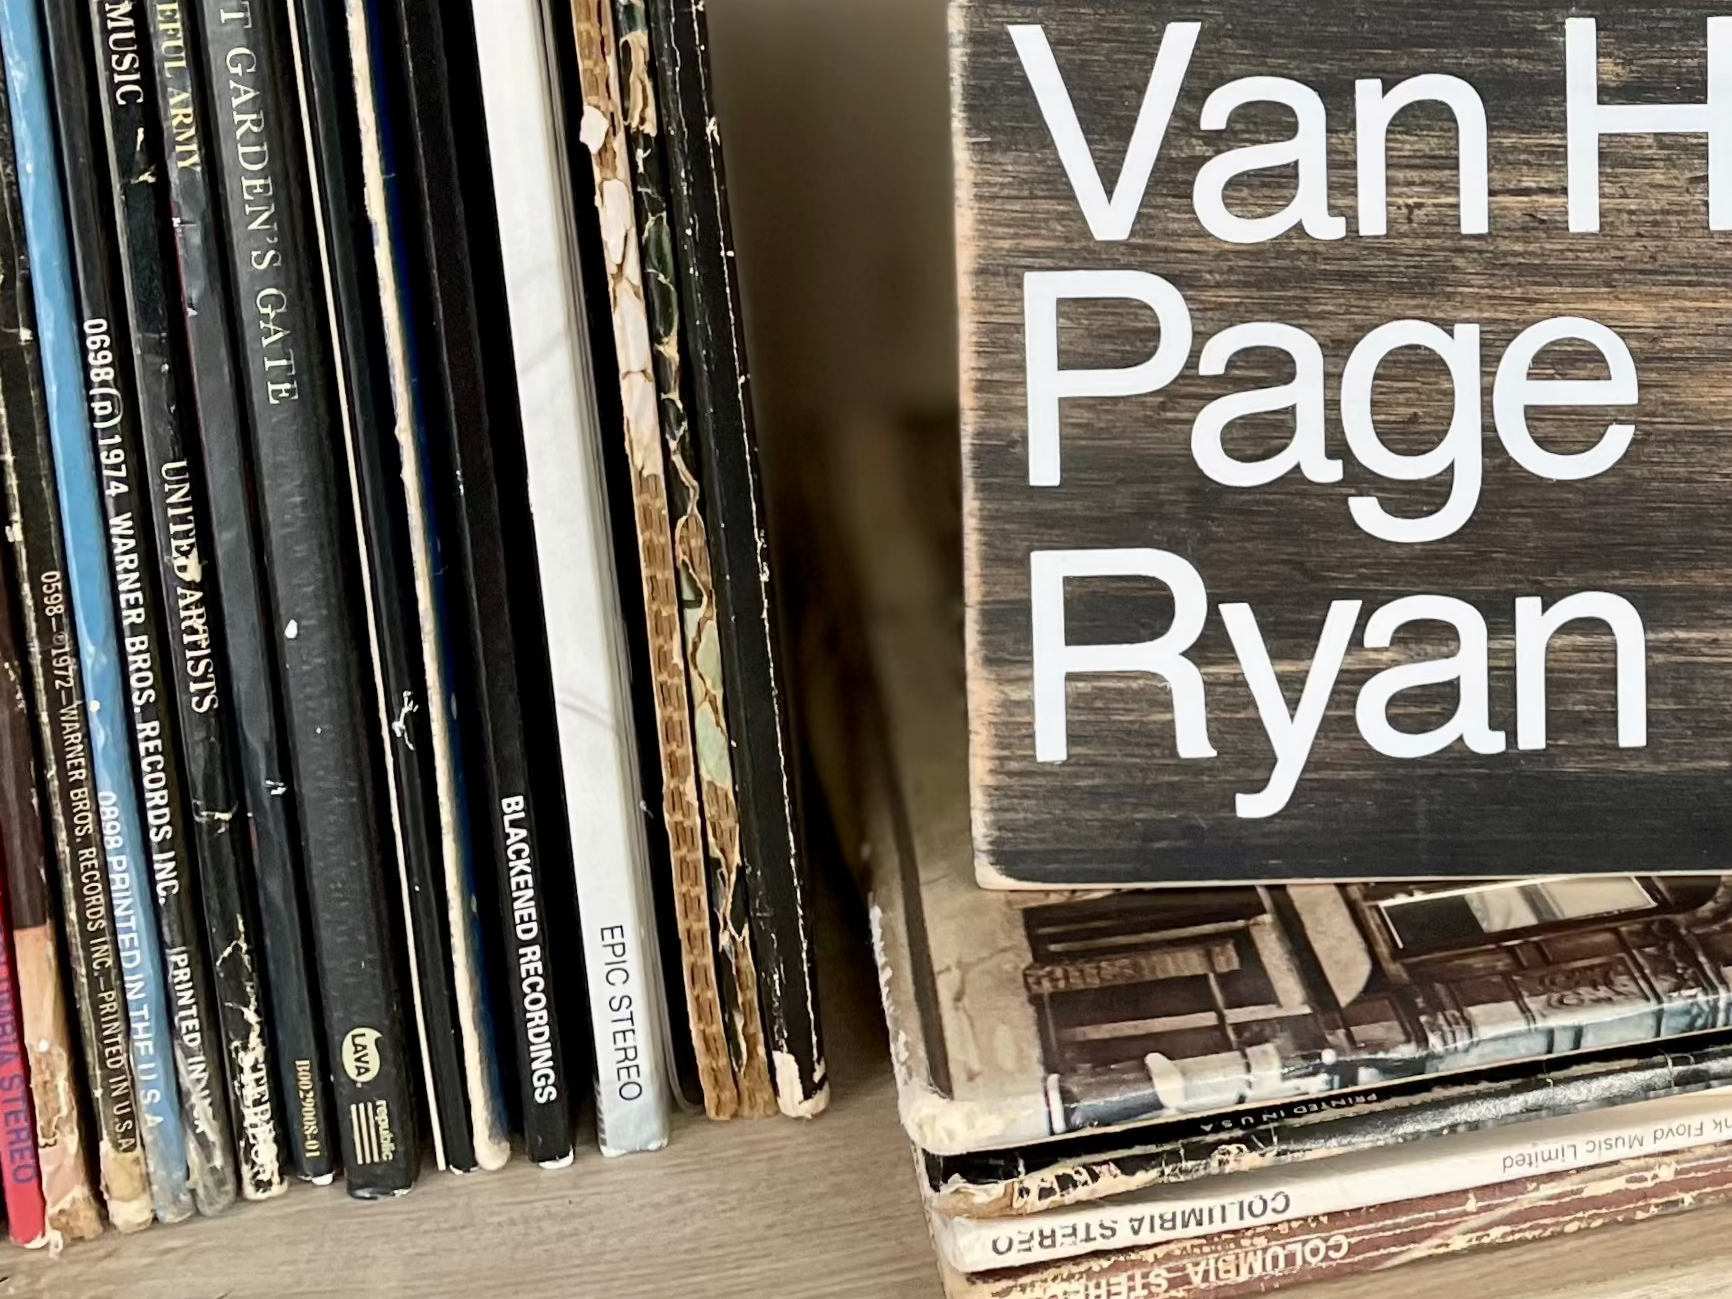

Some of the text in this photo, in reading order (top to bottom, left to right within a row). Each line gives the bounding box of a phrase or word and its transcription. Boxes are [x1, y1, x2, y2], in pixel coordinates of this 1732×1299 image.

[104, 0, 145, 107] MUSIC
[166, 85, 202, 171] ARMY
[1006, 21, 1489, 244] Van
[225, 46, 284, 272] GARDEN'S
[256, 286, 299, 406] GATE
[1023, 270, 1639, 543] Page
[108, 511, 148, 628] WARNER
[124, 633, 156, 714] BROS.
[176, 586, 219, 714] ARTISTS
[1030, 548, 1647, 819] Ryan
[69, 786, 93, 843] BROS.
[98, 790, 121, 850] 0898
[136, 720, 173, 845] RECORDS
[78, 848, 106, 932] RECORDS
[108, 855, 141, 969] PRINTED
[153, 849, 181, 904] INC.
[125, 976, 147, 1002] IN
[501, 794, 558, 1105] BLACKENED RECORDINGS
[130, 1004, 155, 1058] THE
[171, 952, 201, 1049] PRINTED
[600, 924, 644, 1102] EPIC STEREO
[108, 1070, 130, 1097] IN
[350, 1032, 372, 1078] LAVA
[0, 1072, 37, 1186] STEREO
[374, 1099, 394, 1162] republic
[1258, 1108, 1287, 1122] IN
[1291, 1092, 1379, 1117] PRINTED
[1591, 1131, 1646, 1156] Music
[1652, 1120, 1705, 1145] Floyd
[1501, 1142, 1578, 1173] Limited
[991, 1190, 1292, 1256] COLUMBIA STEREO
[1186, 1234, 1351, 1286] COLUMBIA
